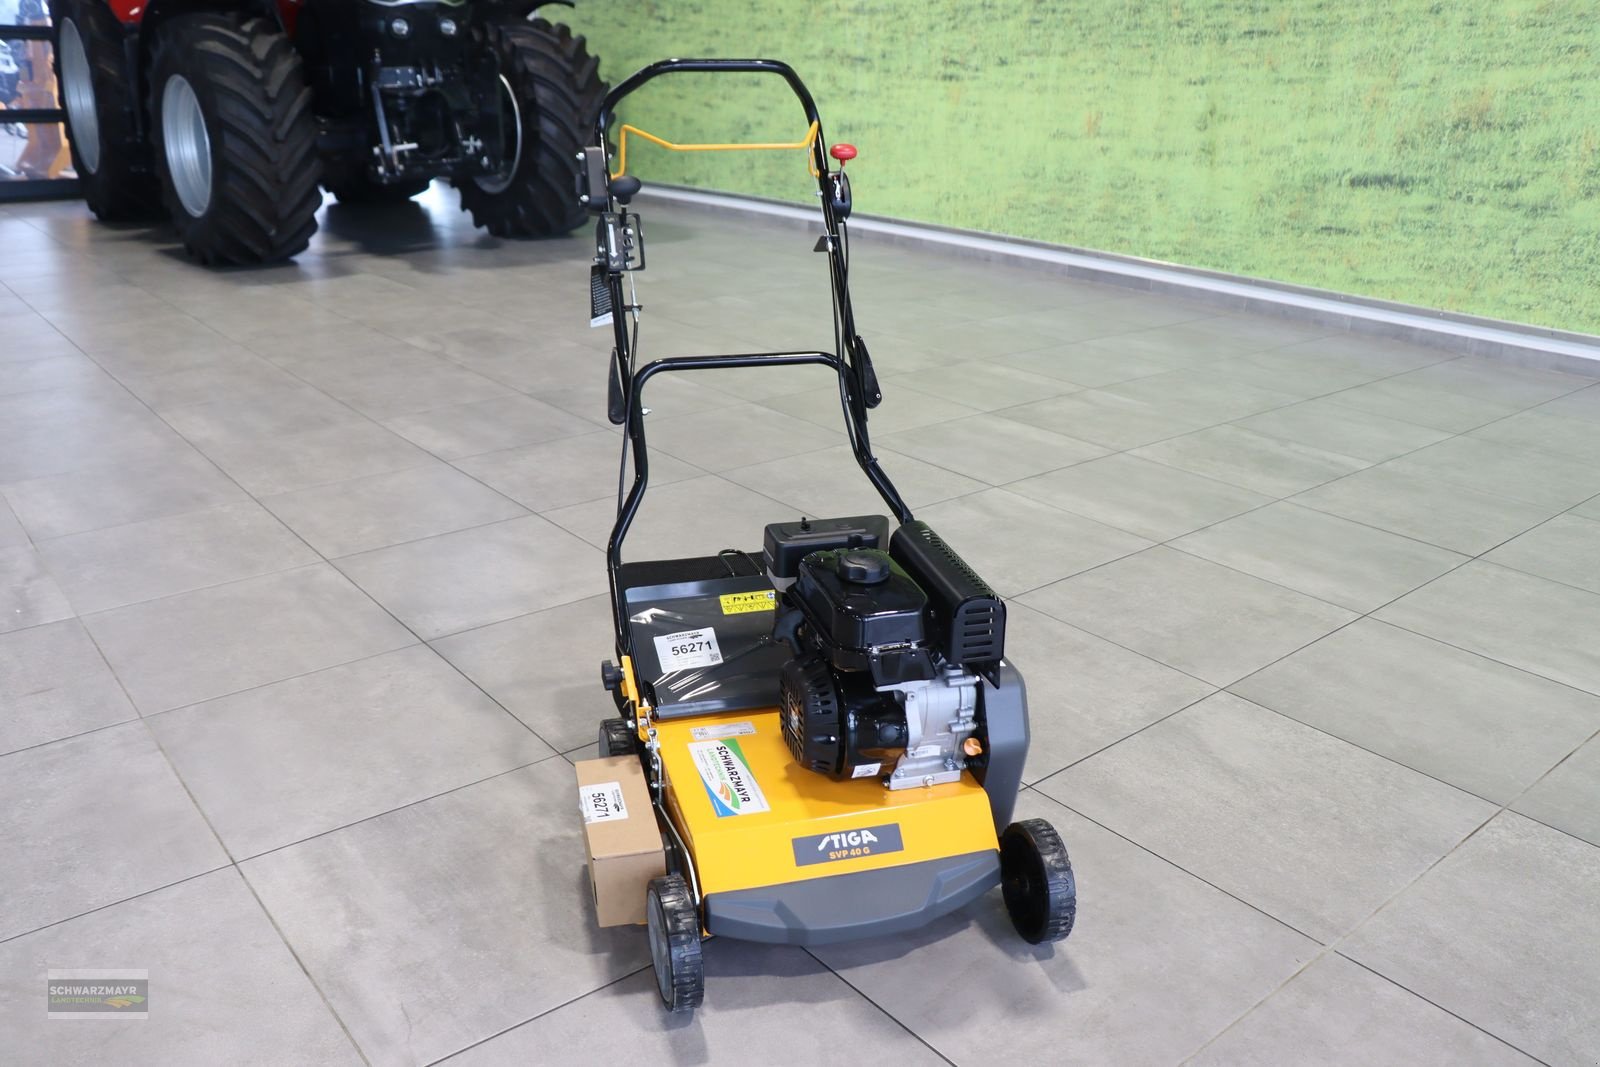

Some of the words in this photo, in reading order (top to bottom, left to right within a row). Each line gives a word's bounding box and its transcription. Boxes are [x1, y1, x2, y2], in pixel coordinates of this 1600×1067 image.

[671, 640, 712, 656] 56271
[716, 745, 751, 803] SCHWARZMAYR
[592, 792, 610, 818] 56271
[817, 829, 878, 851] STIGA
[829, 850, 849, 860] SVP
[850, 848, 862, 857] 40
[863, 846, 871, 855] G
